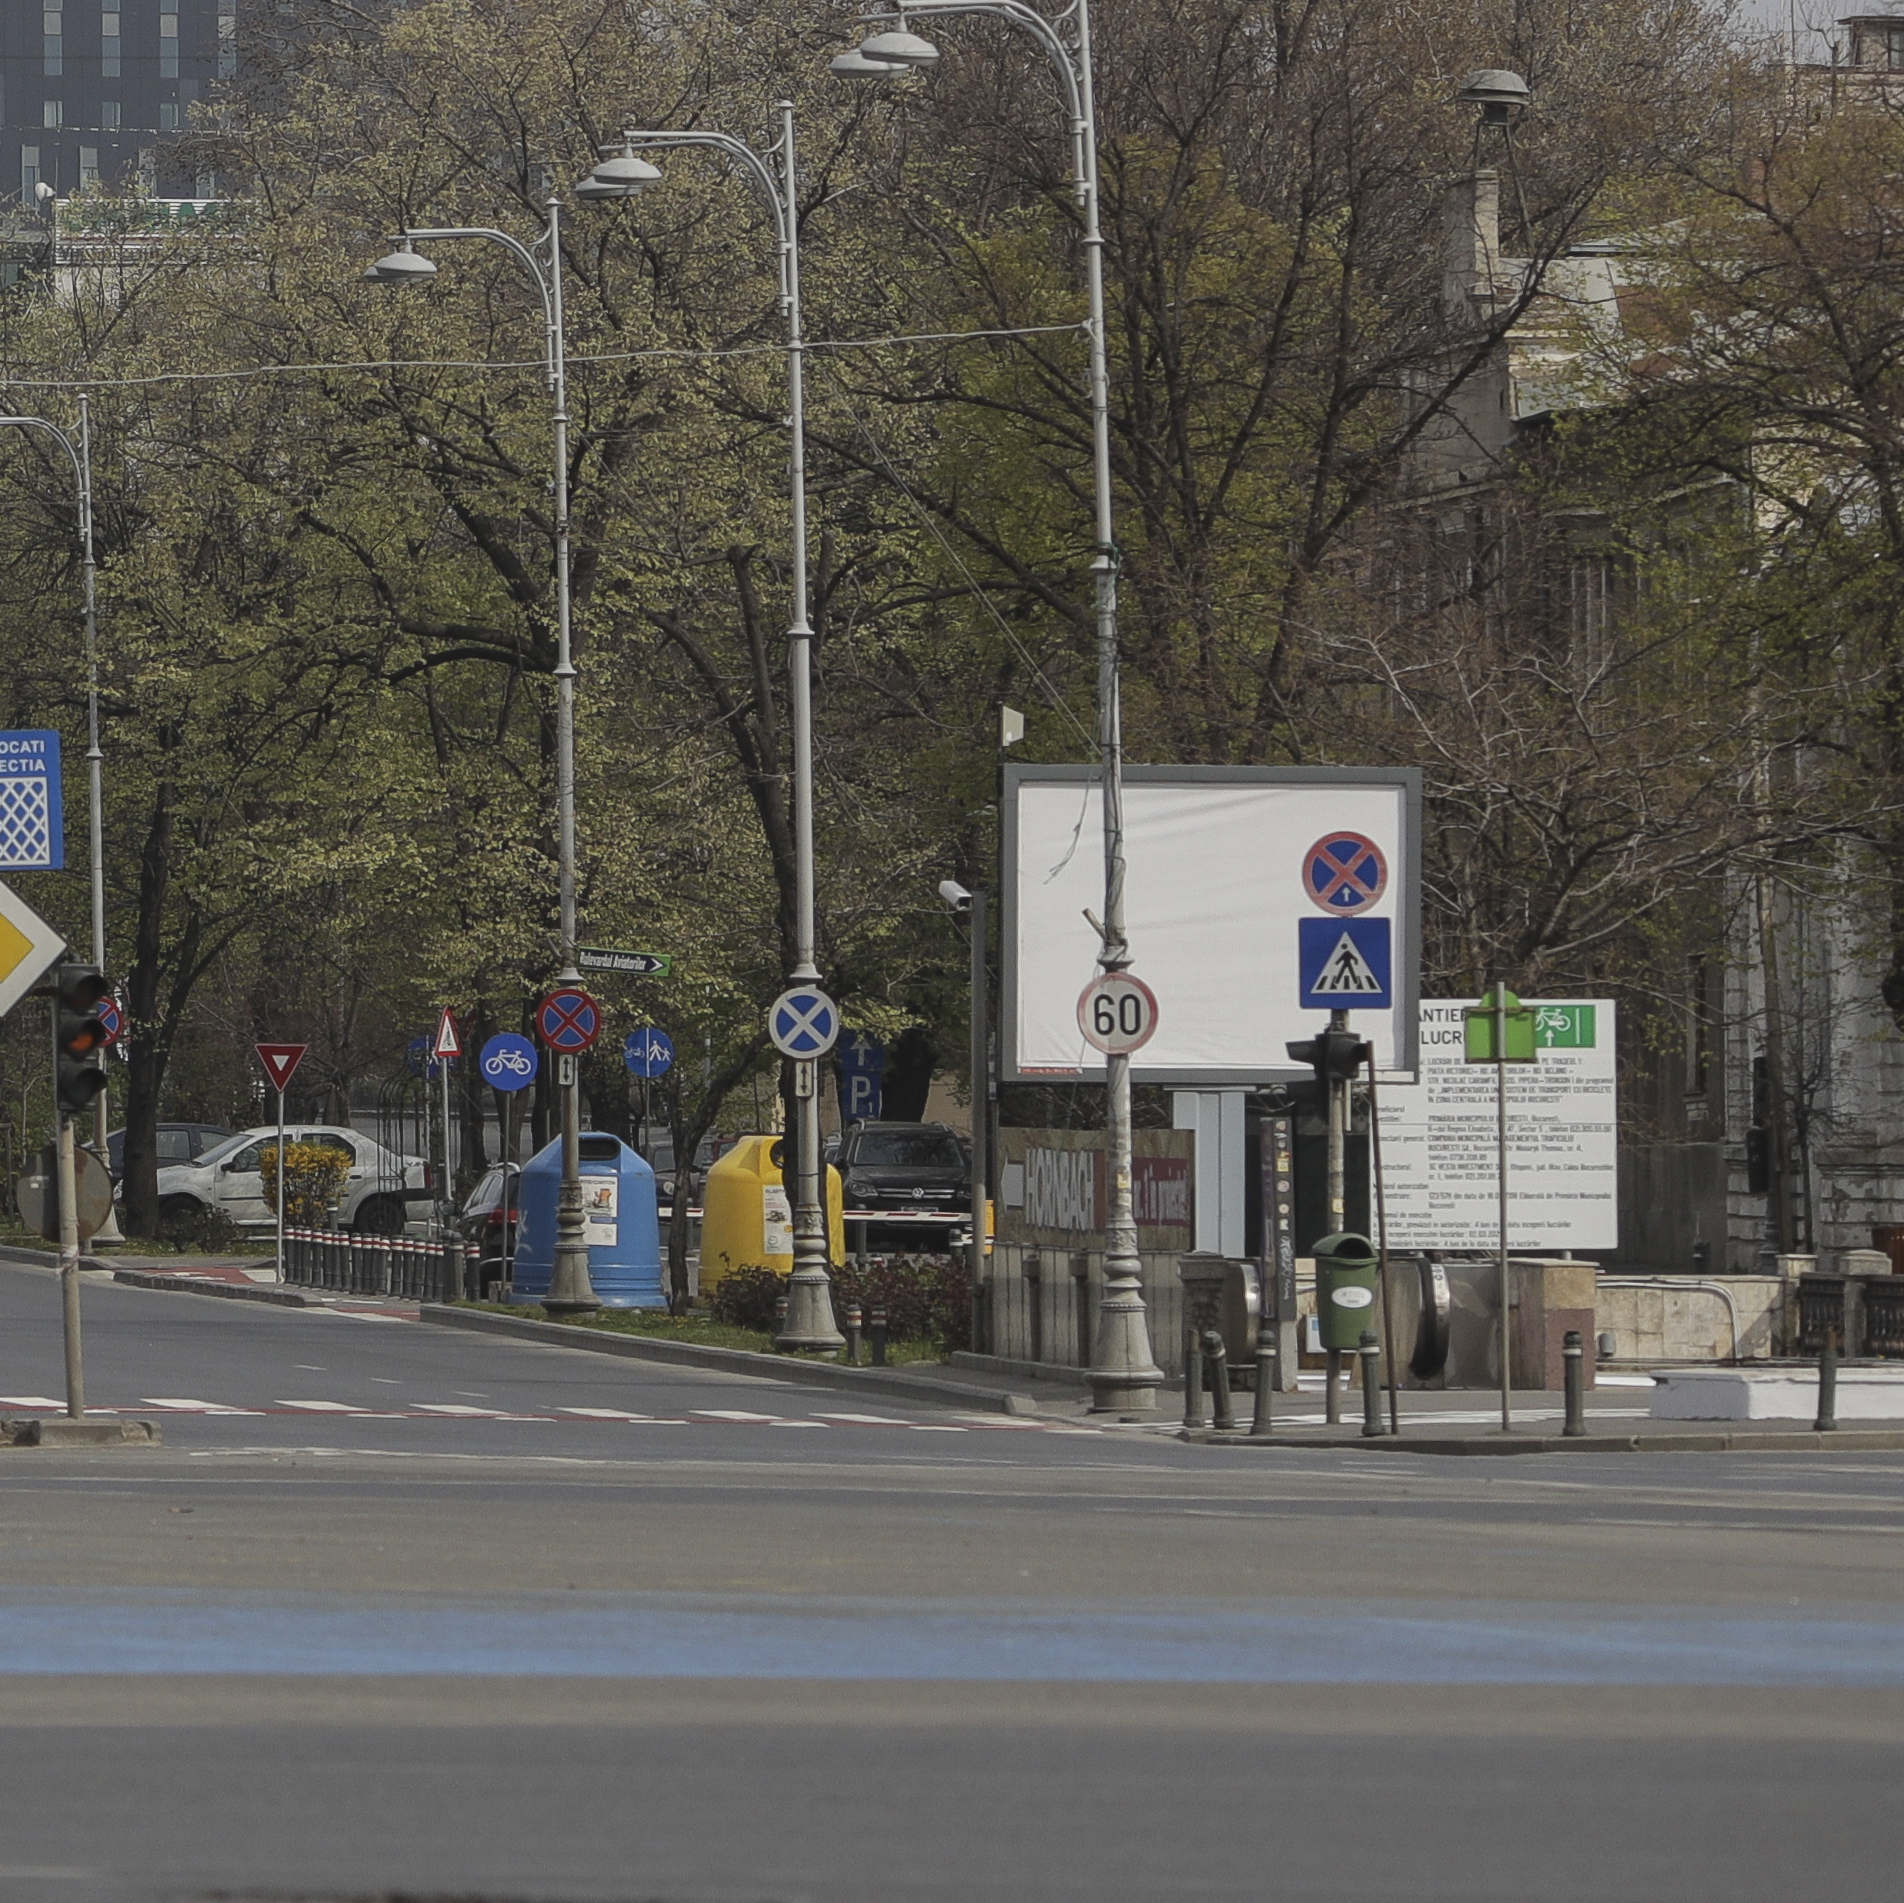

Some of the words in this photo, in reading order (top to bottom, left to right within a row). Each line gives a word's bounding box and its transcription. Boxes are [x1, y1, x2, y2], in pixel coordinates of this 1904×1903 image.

[1093, 993, 1141, 1036] 60
[1421, 1030, 1463, 1045] LUCR
[851, 1075, 871, 1114] P
[1026, 1147, 1095, 1231] HORNBACH
